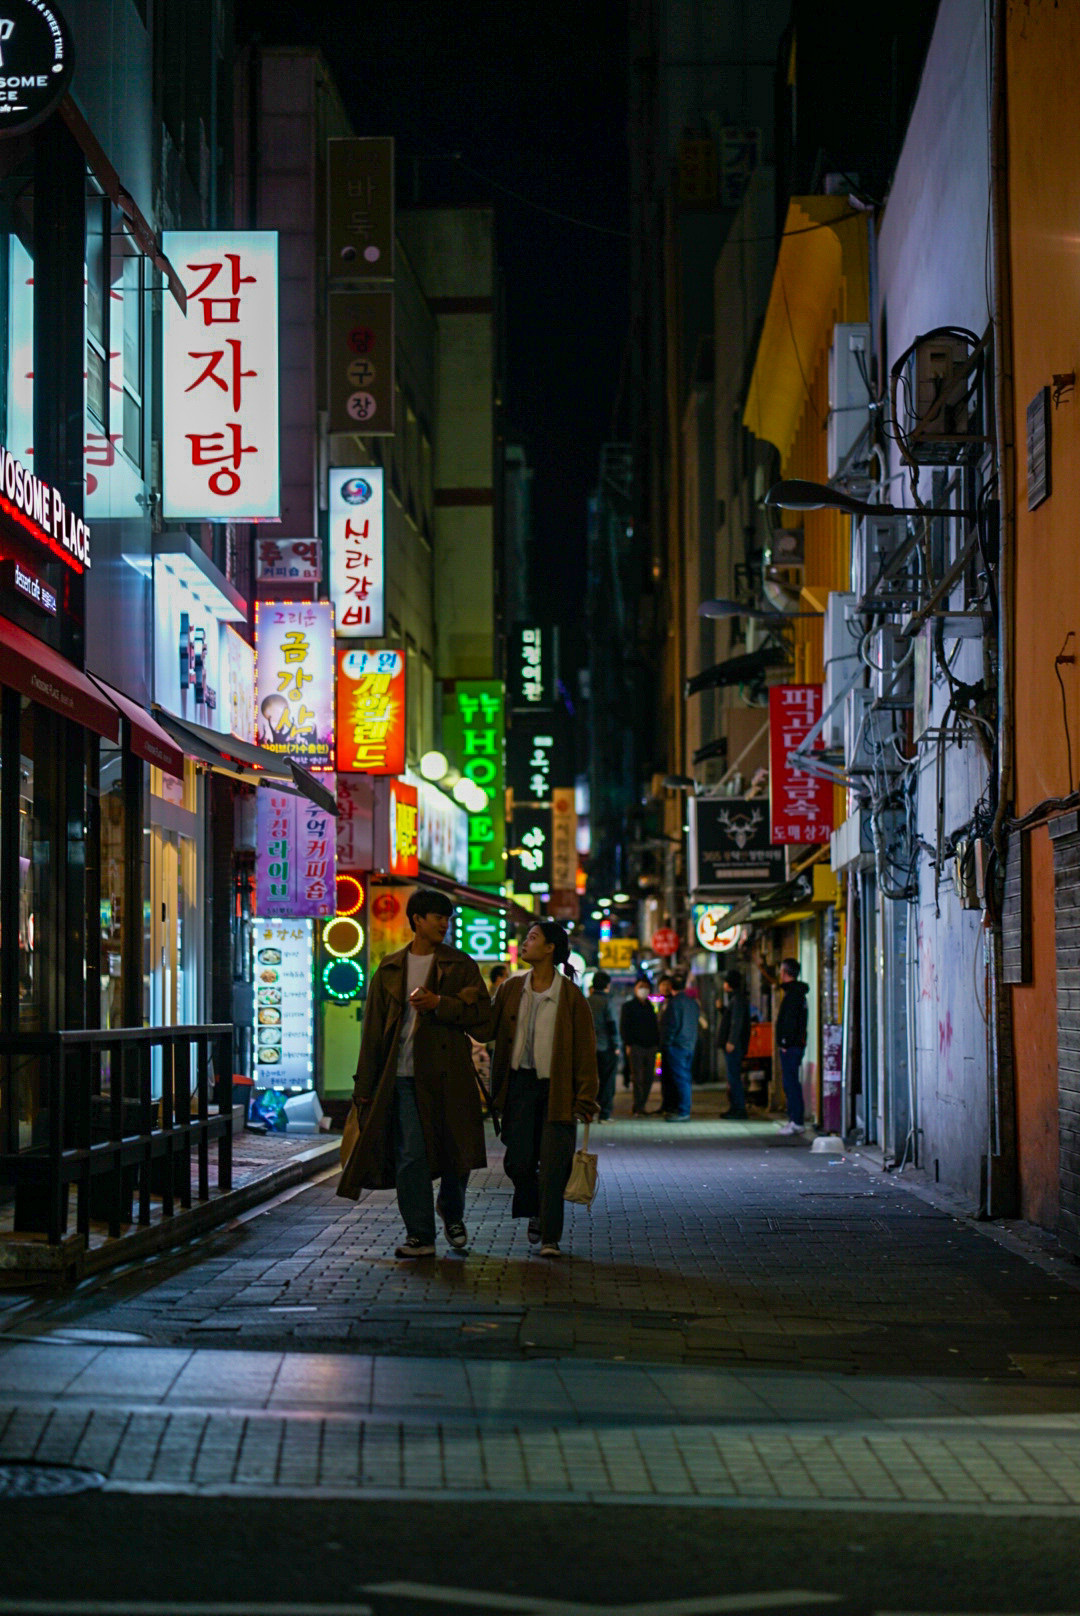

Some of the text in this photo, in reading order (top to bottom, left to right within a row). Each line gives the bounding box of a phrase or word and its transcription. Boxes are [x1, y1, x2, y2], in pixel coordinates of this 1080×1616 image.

[43, 9, 62, 37] SWEET
[54, 37, 63, 60] TIME
[184, 253, 258, 496] 감자탕
[52, 486, 91, 569] PLACE
[260, 541, 317, 567] 추억
[341, 517, 373, 627] 신라갈비
[274, 631, 316, 738] 금강산
[781, 688, 821, 822] 파고다금속
[773, 824, 831, 841] 도매상가
